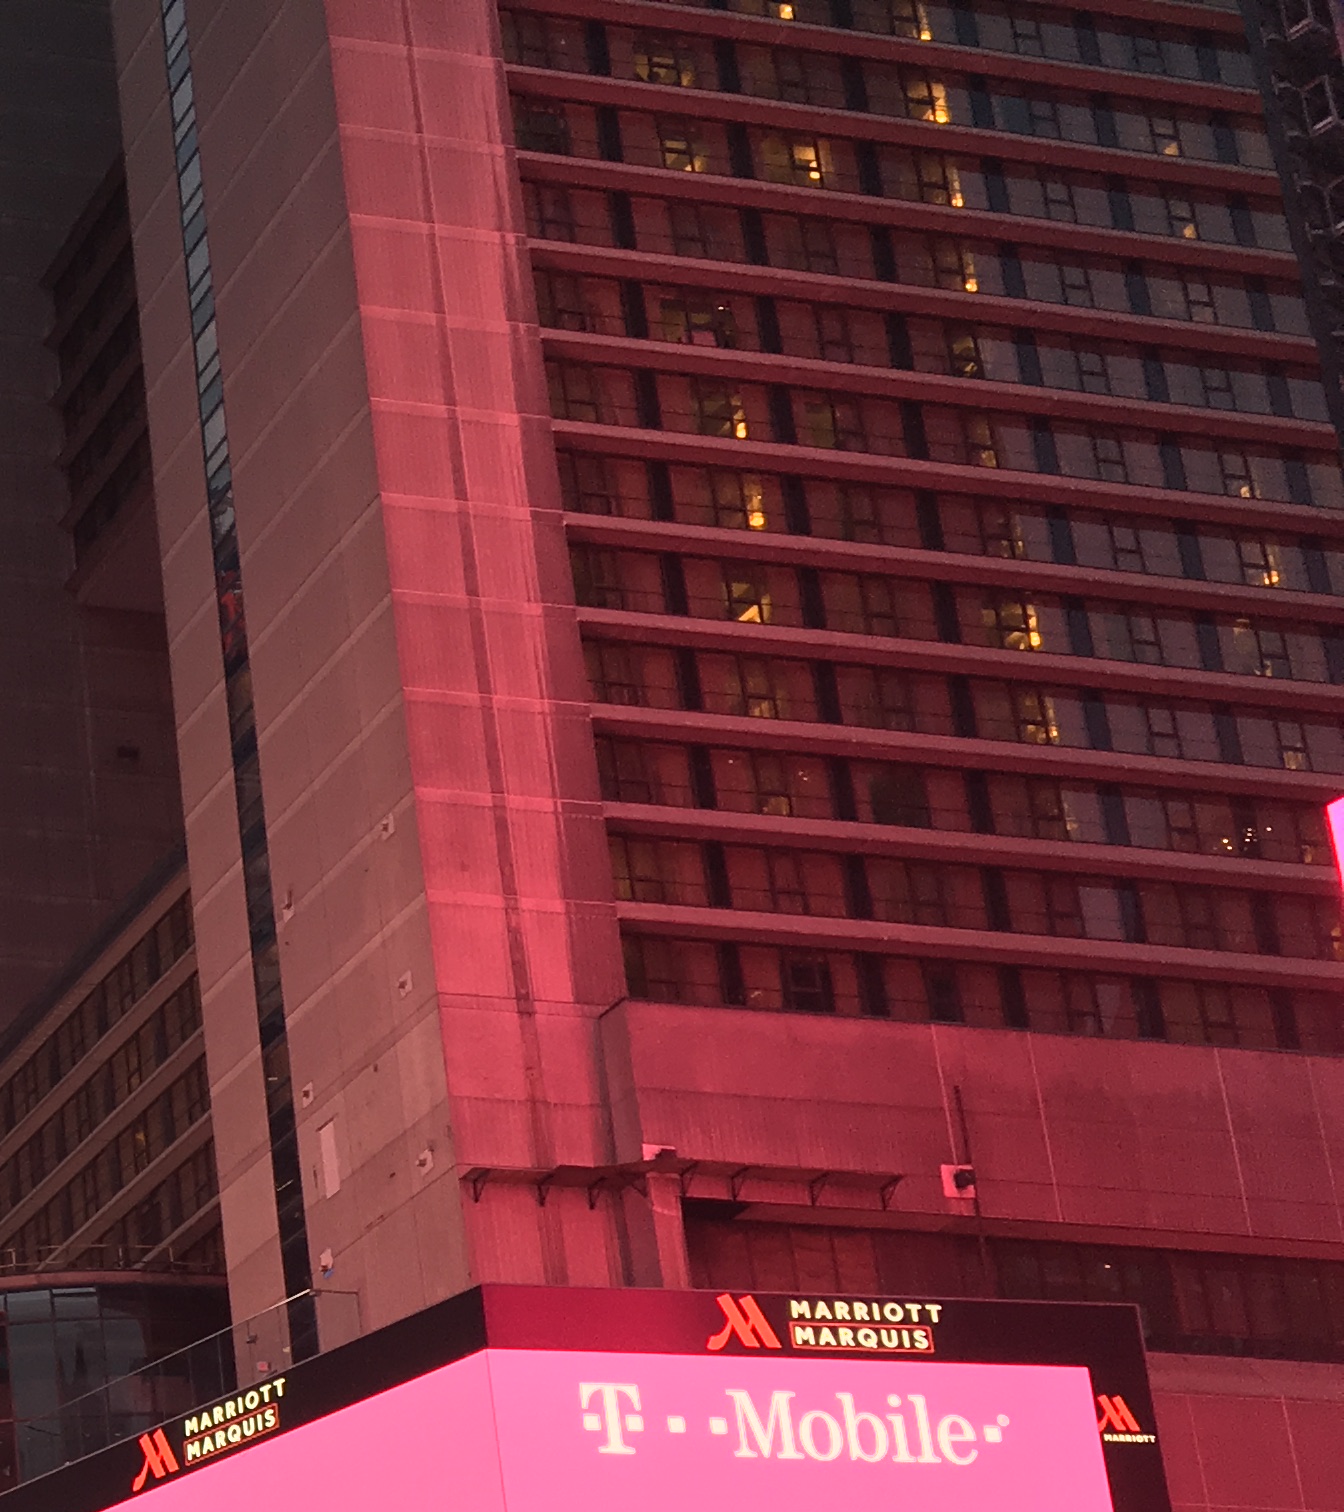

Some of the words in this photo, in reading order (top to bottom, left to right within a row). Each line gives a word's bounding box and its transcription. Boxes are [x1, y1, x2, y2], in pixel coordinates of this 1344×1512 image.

[790, 1299, 943, 1324] MARRIOTT
[794, 1326, 930, 1350] MARQUIS
[184, 1377, 286, 1437] MARRIOTT
[186, 1408, 276, 1461] MARQUIS
[1103, 1432, 1156, 1443] MARRIOTT
